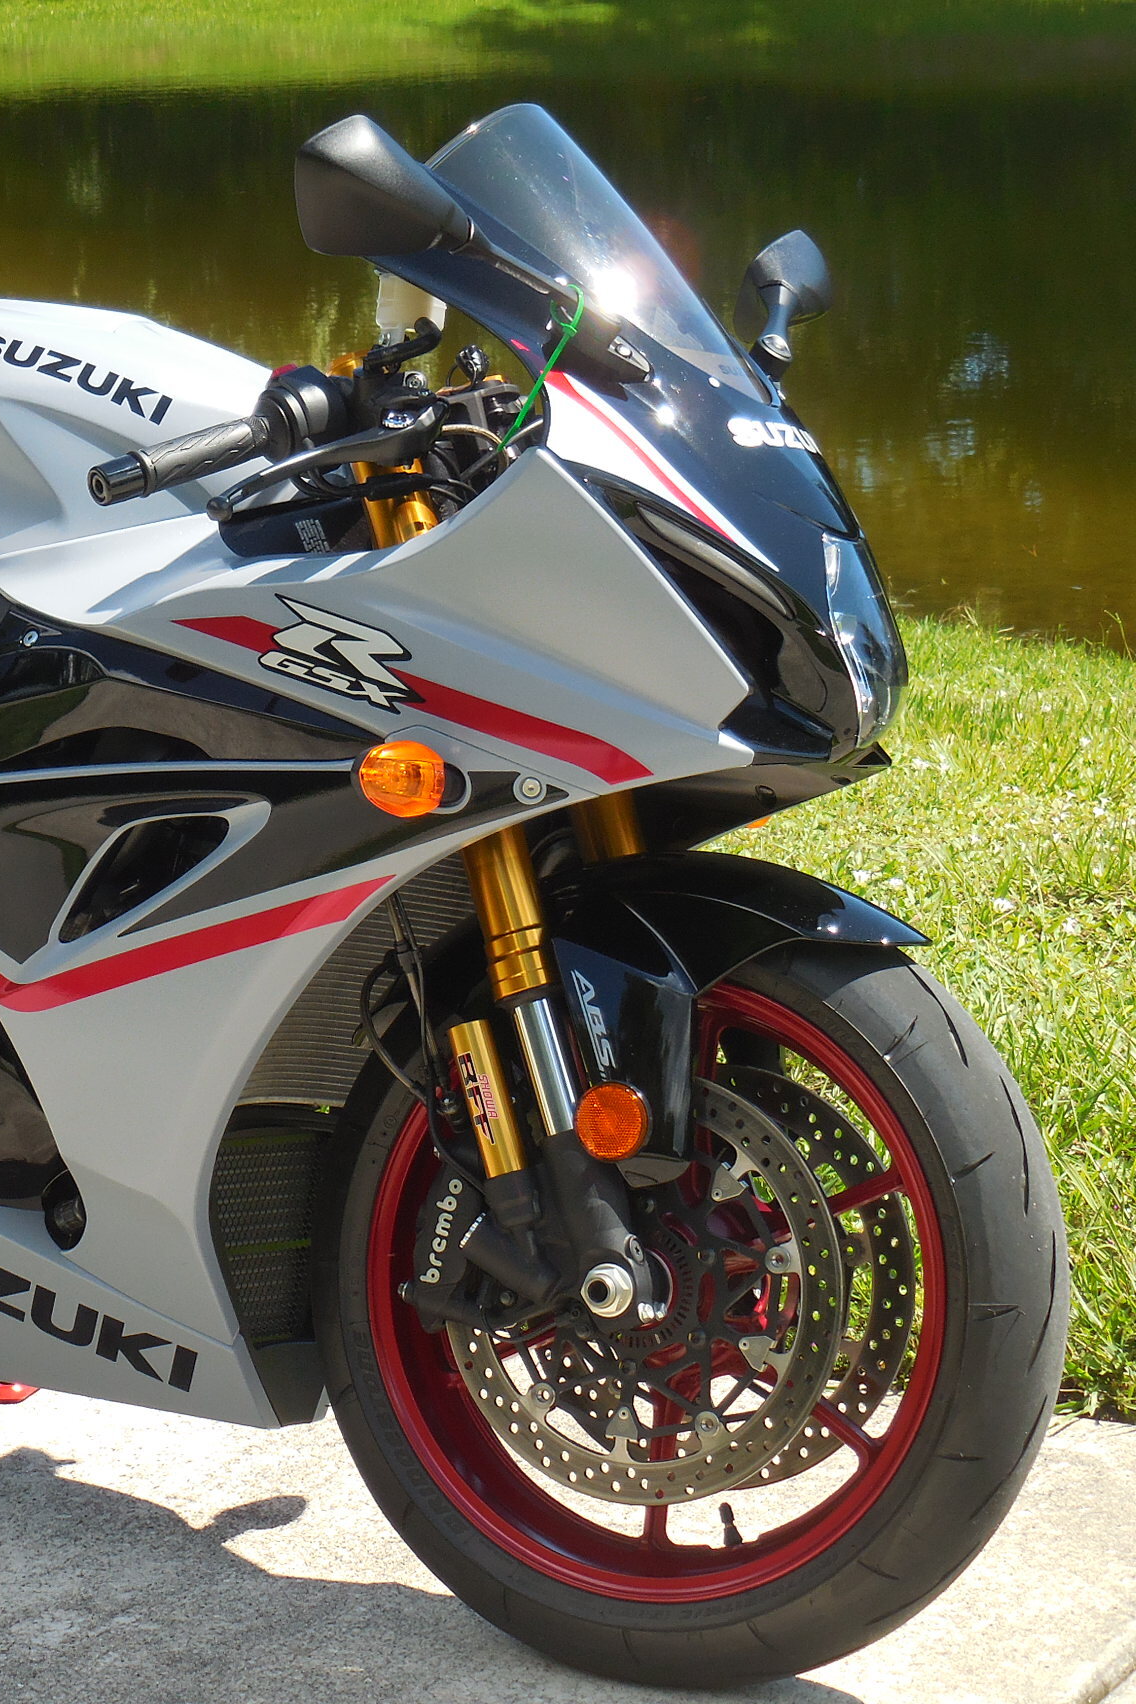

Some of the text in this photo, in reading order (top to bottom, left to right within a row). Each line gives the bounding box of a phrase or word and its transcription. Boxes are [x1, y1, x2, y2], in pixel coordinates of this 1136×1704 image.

[726, 417, 823, 457] SUZU
[258, 650, 409, 714] GSX
[571, 969, 617, 1071] ABS
[477, 1073, 499, 1119] SHOWA
[420, 1178, 463, 1284] brembo
